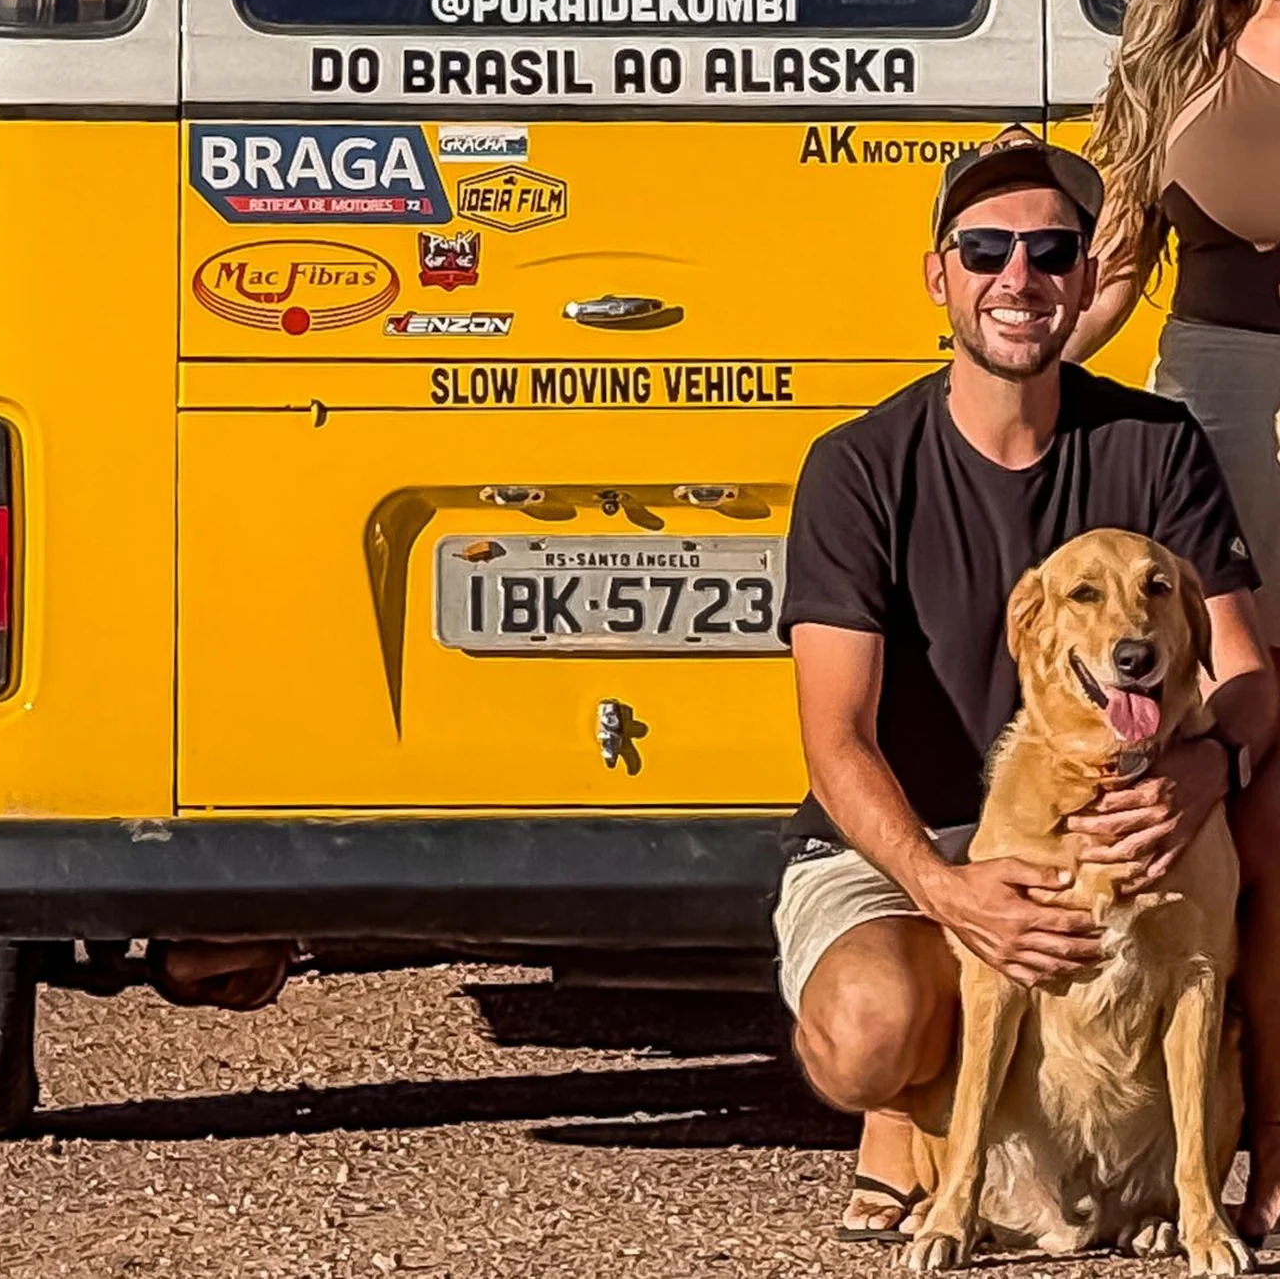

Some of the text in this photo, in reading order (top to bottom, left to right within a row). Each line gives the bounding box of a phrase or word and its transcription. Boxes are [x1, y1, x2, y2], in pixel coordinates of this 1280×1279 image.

[312, 48, 915, 95] DO BRASIL AO ALASKA
[201, 136, 426, 190] BRAGA
[800, 126, 976, 163] AK MOTORH
[249, 198, 304, 212] RETIFICA
[309, 198, 326, 212] DE
[331, 198, 393, 212] MOTORES
[517, 188, 563, 212] FILM
[431, 366, 793, 404] SLOW MOVING VEHICLE
